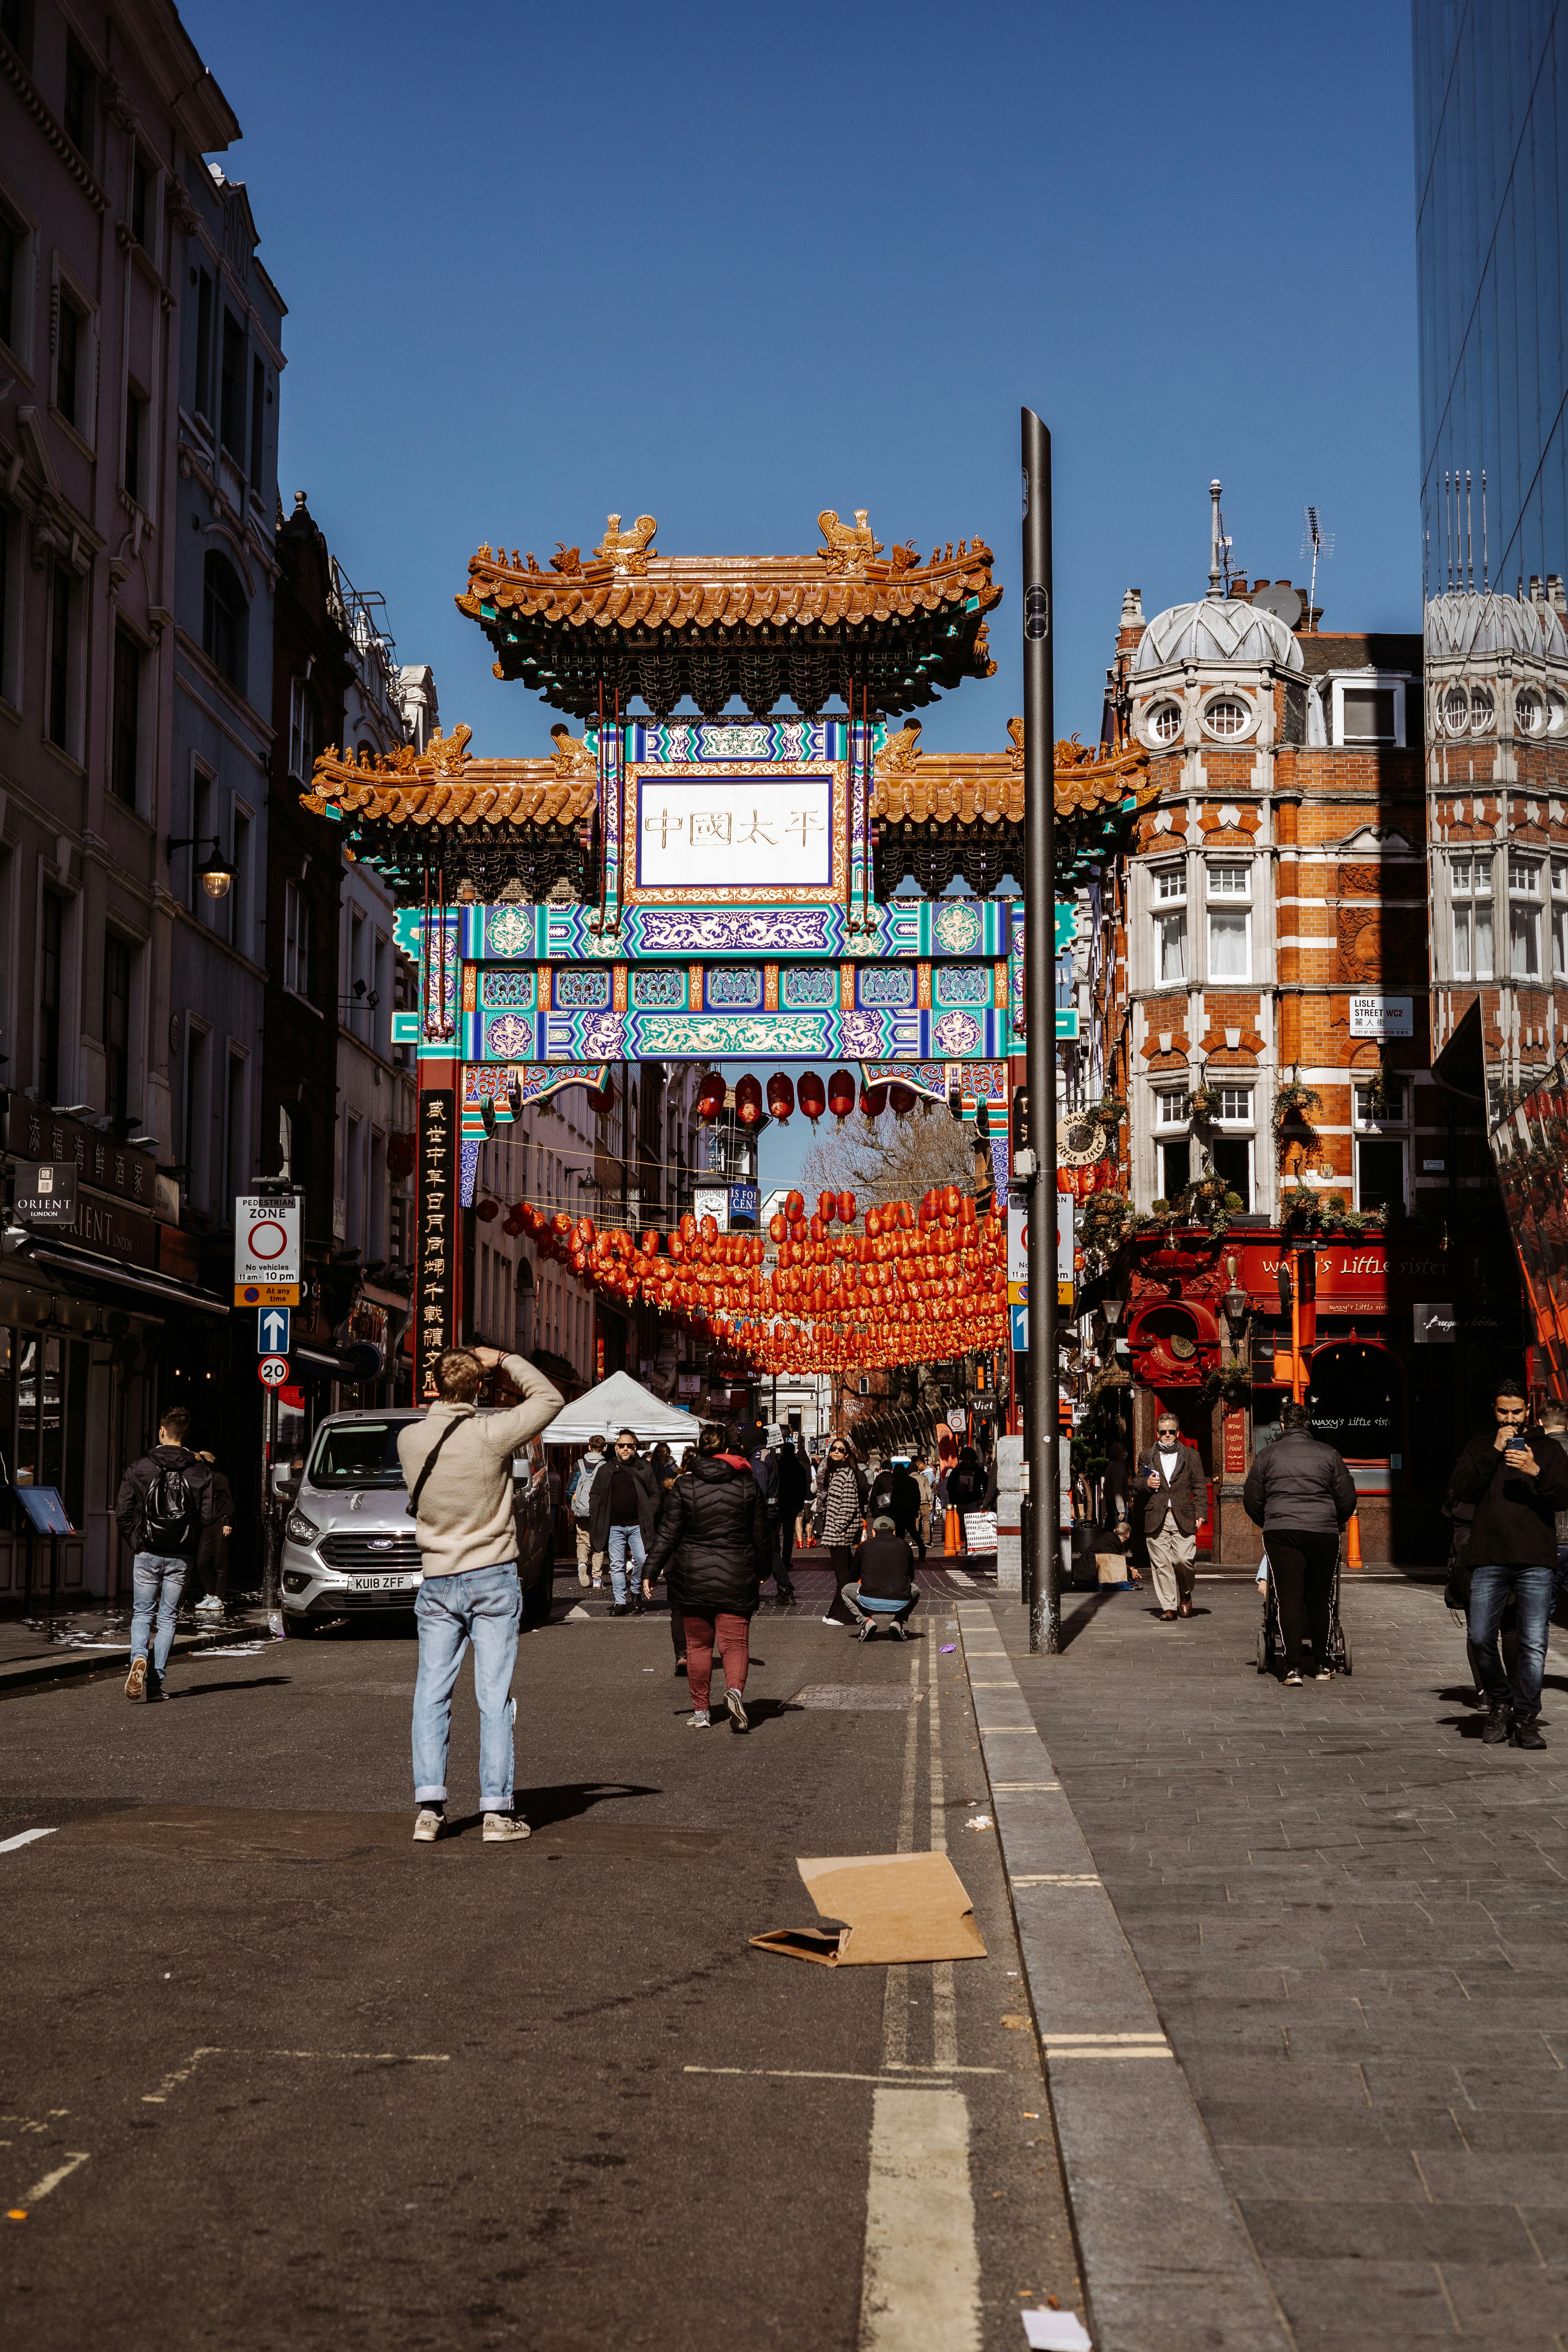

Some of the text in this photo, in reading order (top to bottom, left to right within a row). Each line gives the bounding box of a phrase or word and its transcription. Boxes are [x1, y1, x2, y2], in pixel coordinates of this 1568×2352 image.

[645, 808, 825, 849] 中國太平
[1355, 1018, 1385, 1026] 麗人街
[696, 1190, 726, 1200] COSTUMIER
[17, 1199, 71, 1209] ORIENT
[249, 1208, 286, 1219] ZONE
[113, 1234, 133, 1252] LONDON
[1397, 1257, 1449, 1275] sister
[265, 1272, 277, 1280] 10
[279, 1272, 294, 1282] pm
[263, 1364, 285, 1378] 20
[684, 1375, 695, 1392] 旺記
[355, 1577, 404, 1589] KU18 ZFF
